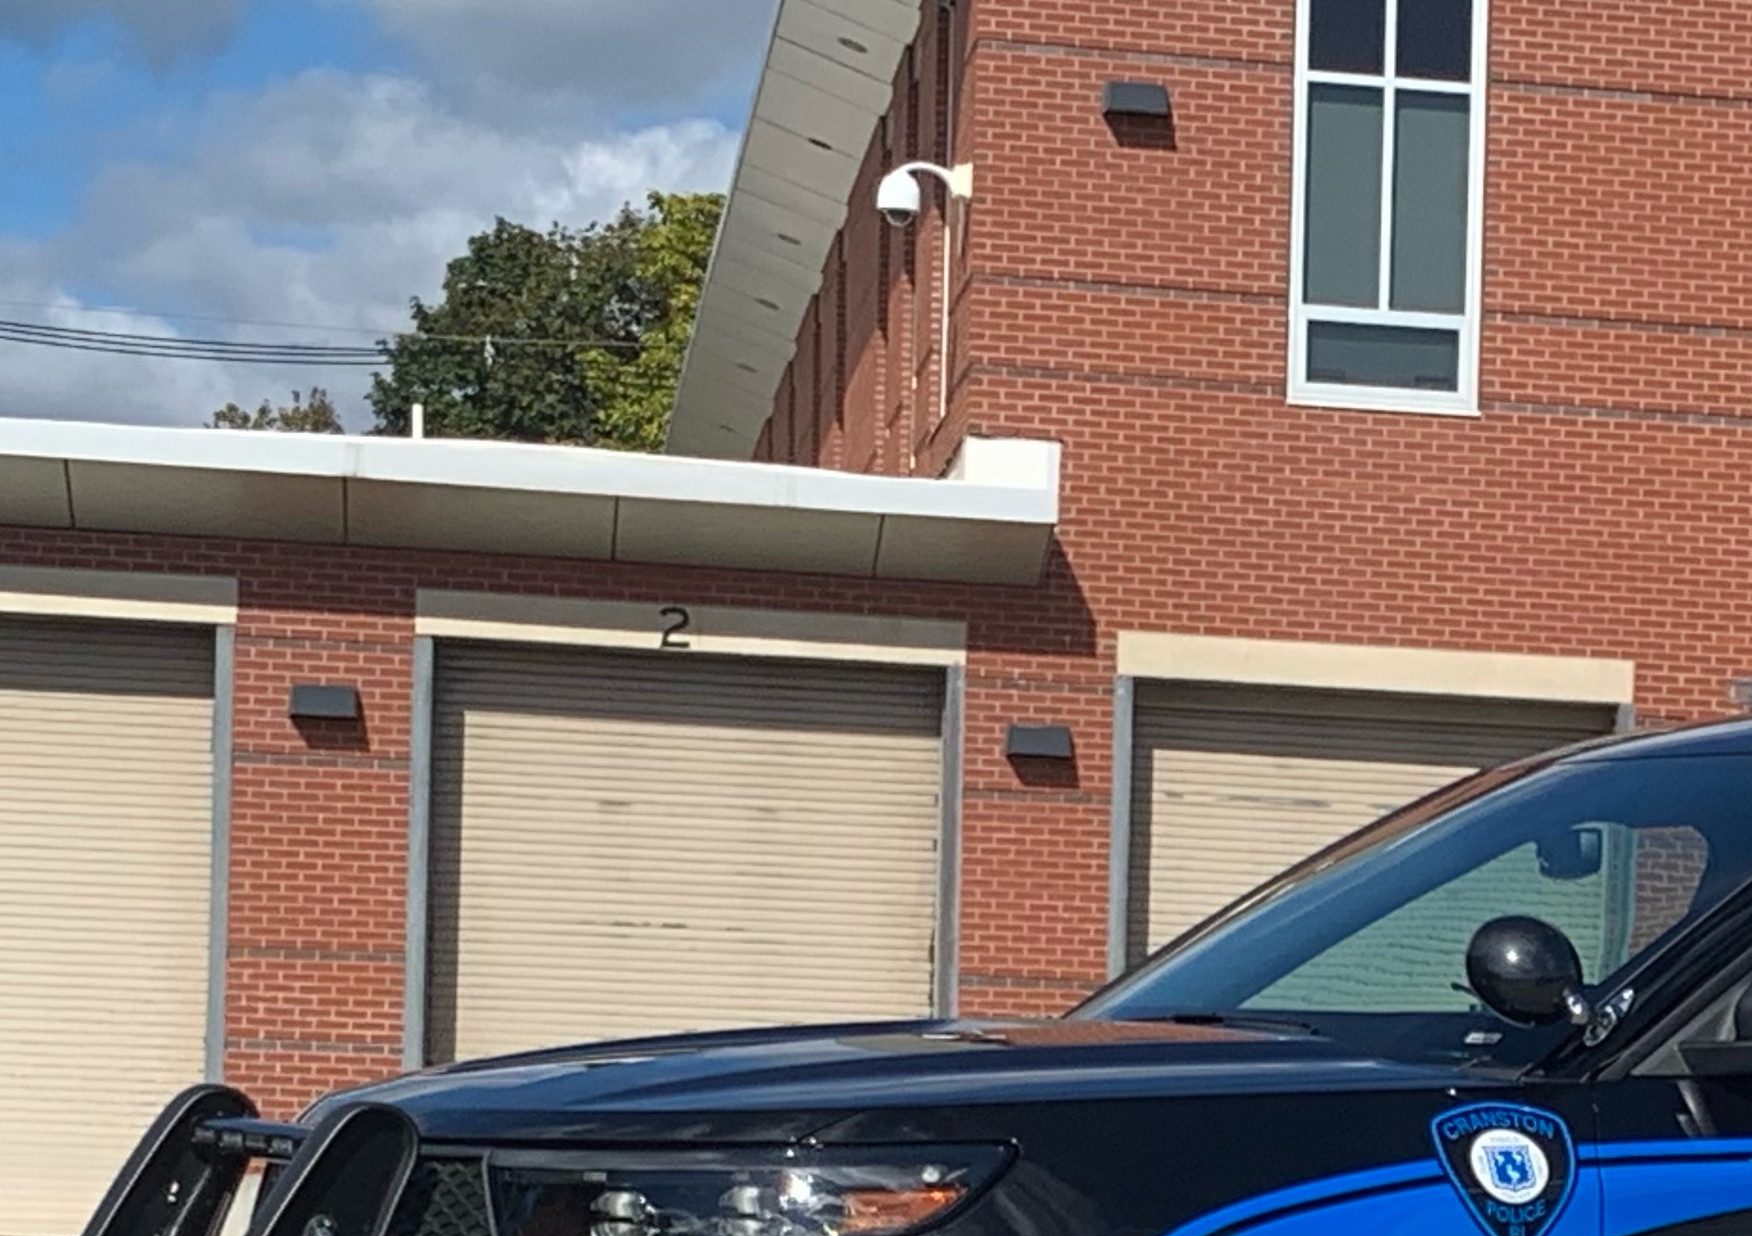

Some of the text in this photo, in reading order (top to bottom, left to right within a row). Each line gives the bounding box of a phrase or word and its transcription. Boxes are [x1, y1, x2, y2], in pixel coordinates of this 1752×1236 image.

[660, 607, 690, 649] 2
[1443, 1110, 1555, 1139] CRANSTON
[1486, 1199, 1546, 1223] POLICE
